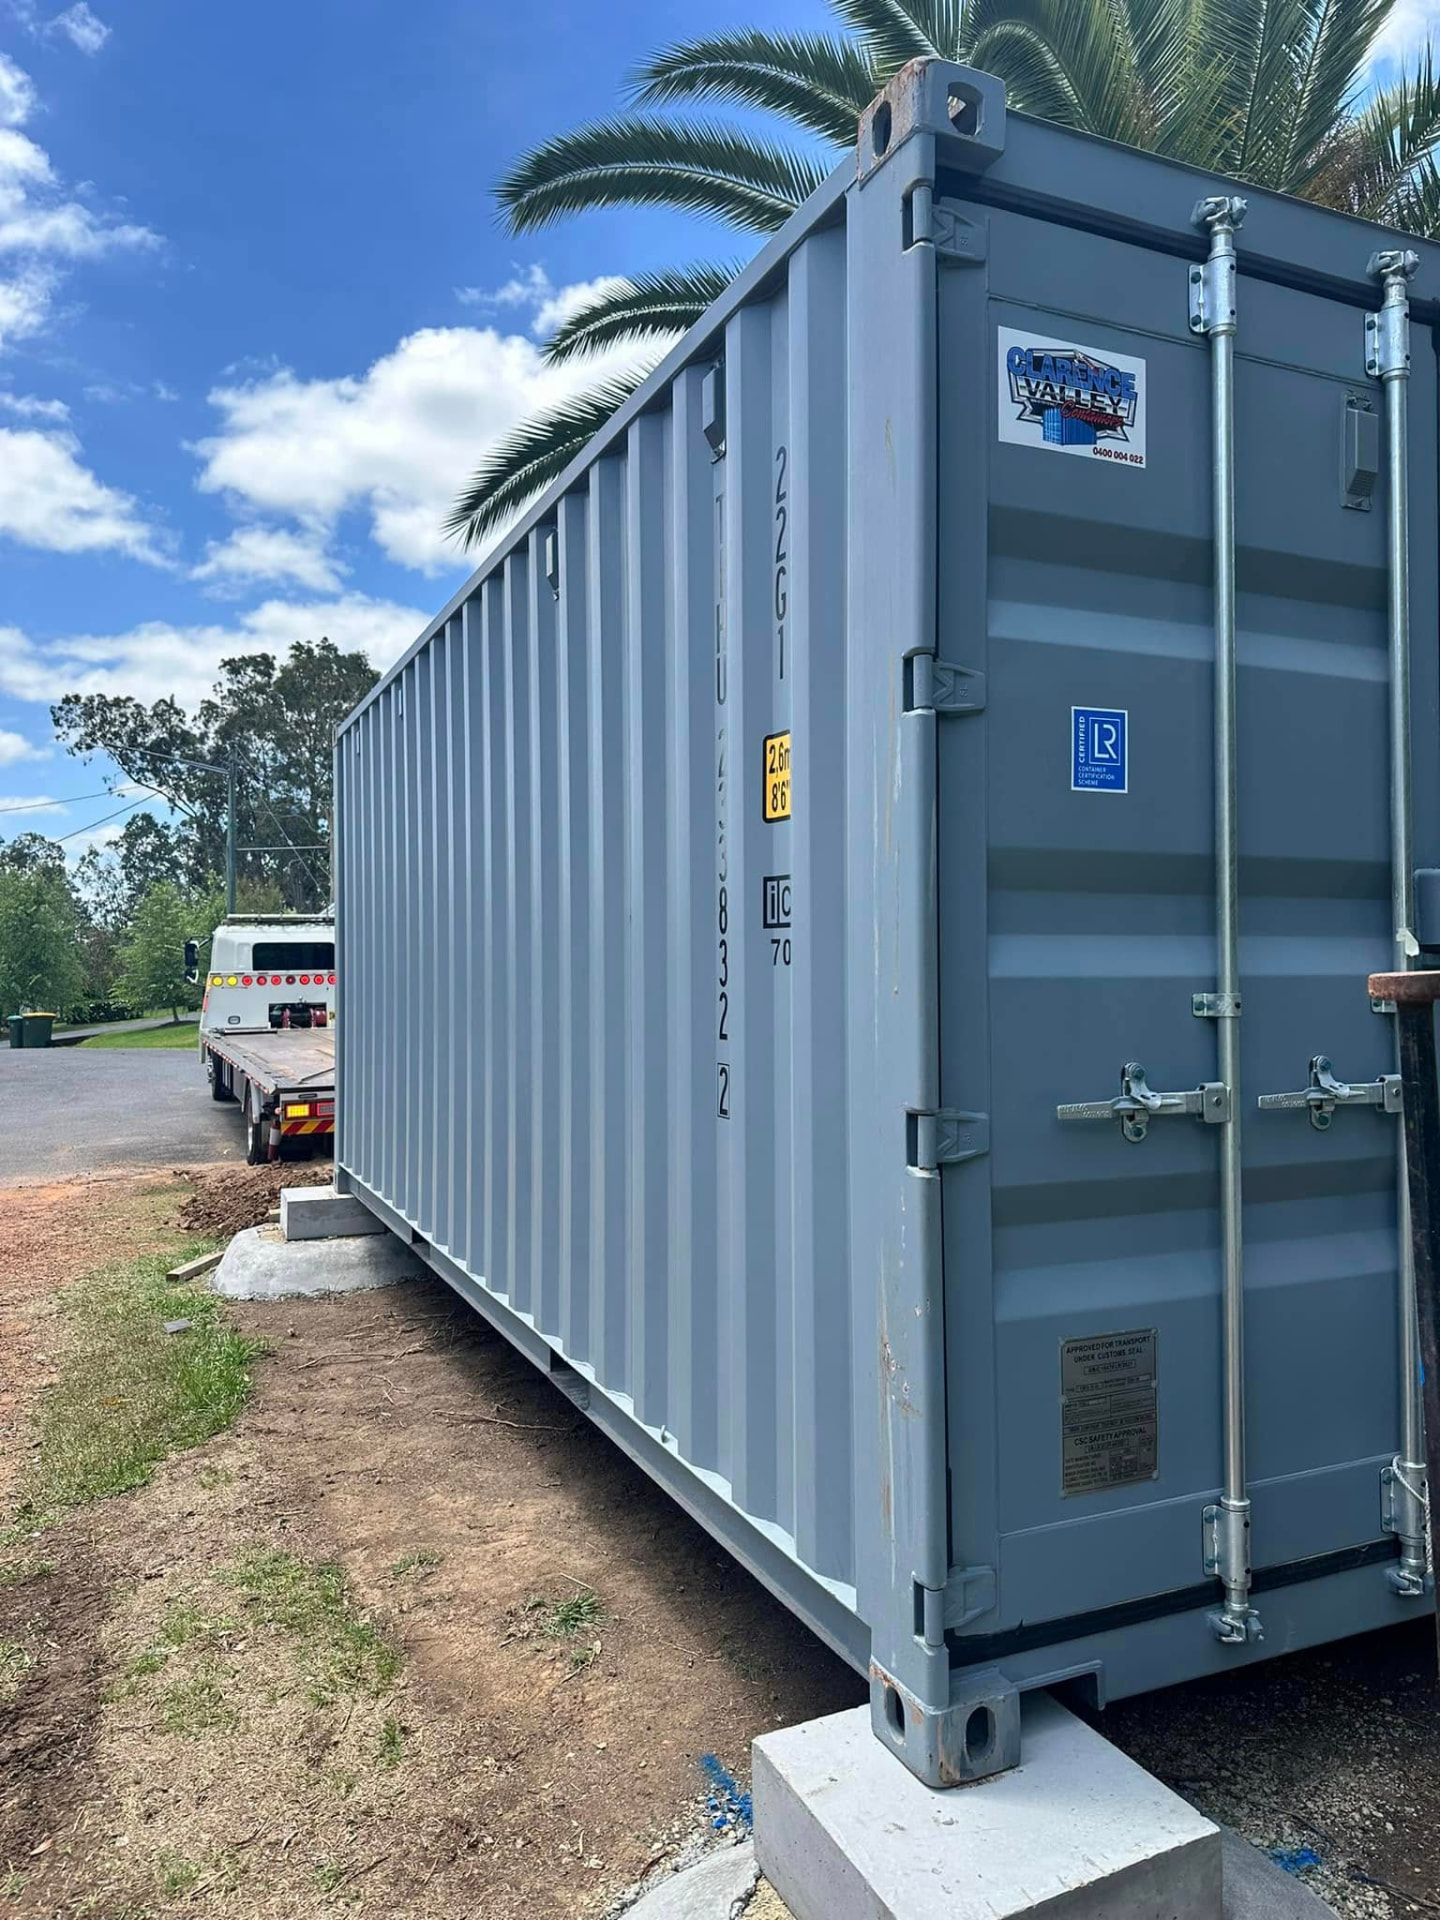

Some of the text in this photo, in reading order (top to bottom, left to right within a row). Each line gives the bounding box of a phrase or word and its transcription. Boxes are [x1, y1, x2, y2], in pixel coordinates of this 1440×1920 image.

[1007, 346, 1136, 400] CLARENCE
[1024, 378, 1123, 415] VALLEY
[1060, 400, 1124, 428] Containers
[1093, 446, 1144, 465] 0400 004 022
[775, 445, 787, 680] 22G1
[1078, 716, 1086, 763] CERTIFIED
[1094, 723, 1117, 759] LR
[1066, 1335, 1151, 1354] APPROVED FOR TRANSPORT
[1073, 1347, 1143, 1363] UNDER CUSTOMS SEAL
[1074, 1426, 1147, 1446] CSC SAFETY APPROVAL
